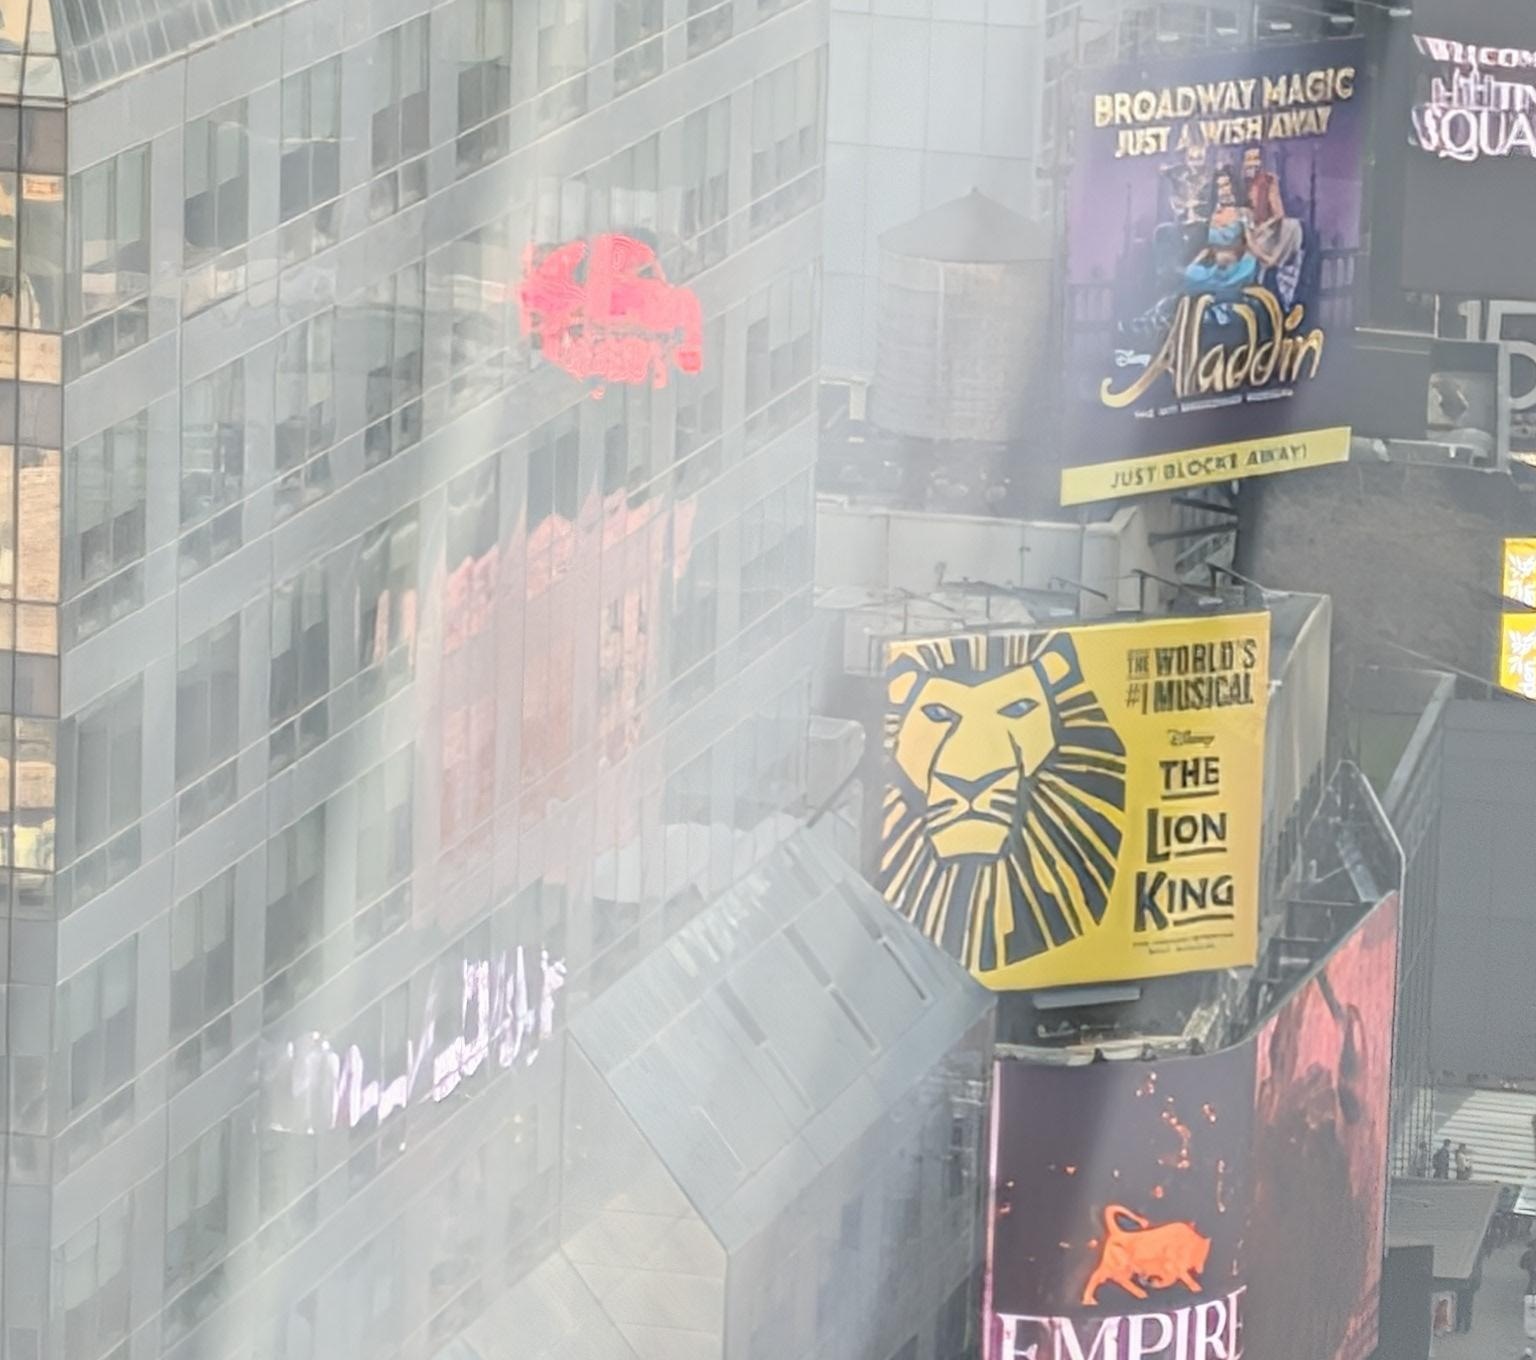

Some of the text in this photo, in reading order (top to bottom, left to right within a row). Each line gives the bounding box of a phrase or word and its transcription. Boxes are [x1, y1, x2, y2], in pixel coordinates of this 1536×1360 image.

[1095, 67, 1355, 127] BROADWAY MAGIC
[1115, 105, 1332, 158] JUST A WISH AWAY
[1101, 286, 1325, 409] Aladdin
[1111, 465, 1157, 489] JUST
[1154, 638, 1257, 676] WORLD'S
[1125, 673, 1254, 715] #1 MUSICAL
[1159, 756, 1220, 790] THE
